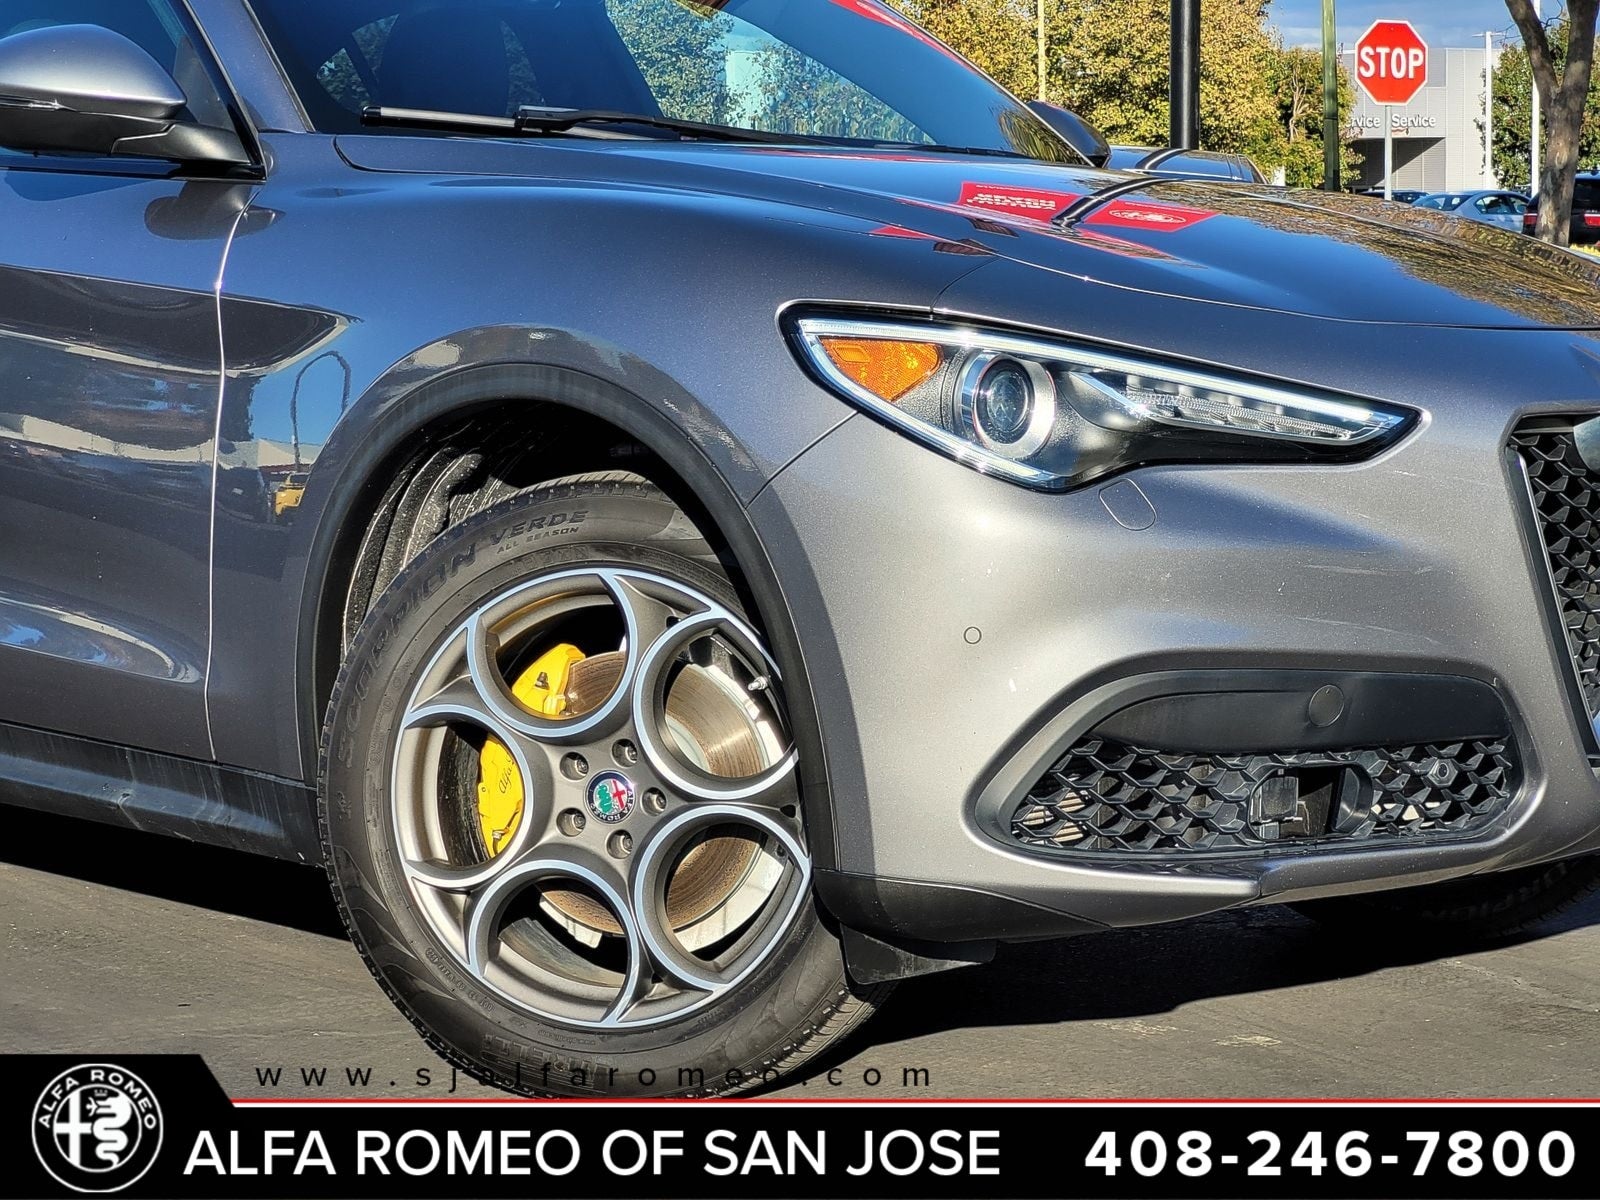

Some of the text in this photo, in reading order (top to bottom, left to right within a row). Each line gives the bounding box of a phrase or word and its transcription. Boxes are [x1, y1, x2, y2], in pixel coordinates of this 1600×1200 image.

[1359, 46, 1424, 79] STOP
[1343, 114, 1381, 128] rvice
[1391, 113, 1436, 128] Service
[490, 510, 589, 546] VERDE
[497, 526, 580, 555] ALL SEASON
